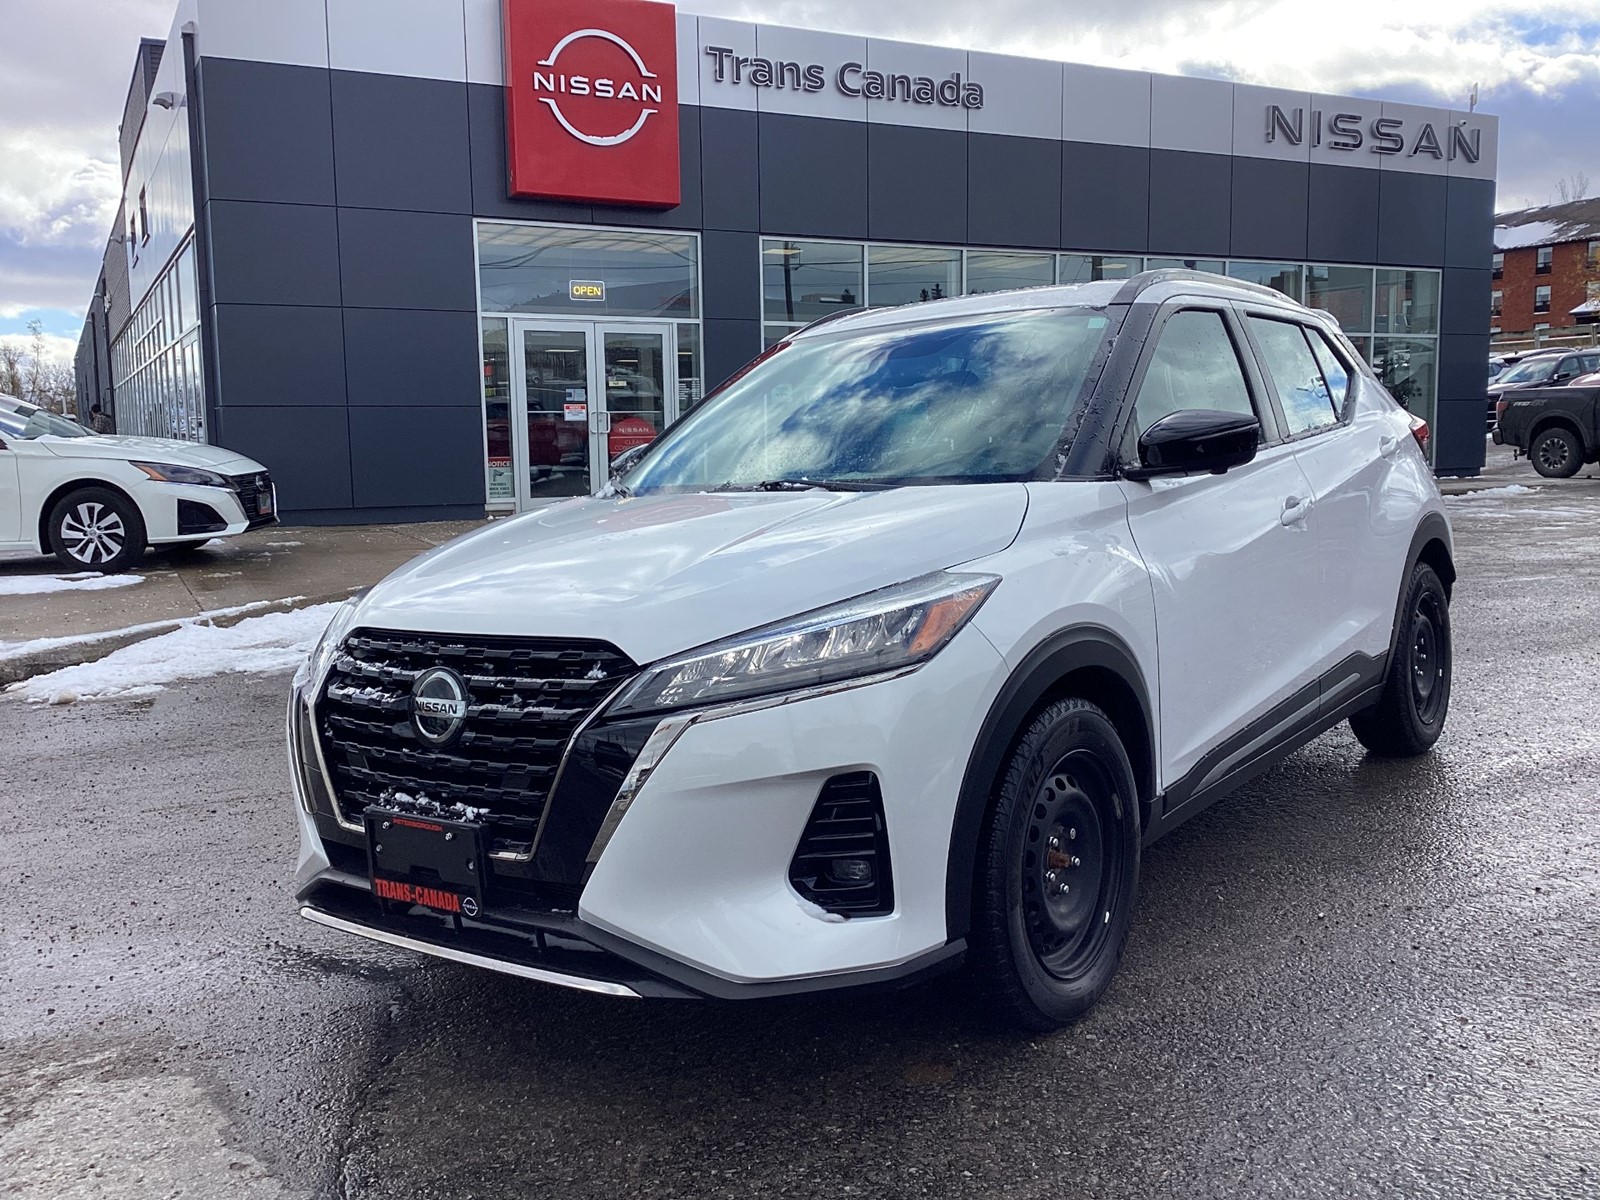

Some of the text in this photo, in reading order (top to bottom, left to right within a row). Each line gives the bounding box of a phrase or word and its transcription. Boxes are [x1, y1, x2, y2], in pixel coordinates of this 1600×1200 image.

[533, 71, 662, 103] NISSAN
[706, 45, 985, 108] Trans Canada
[1265, 104, 1482, 164] NISSAN
[573, 285, 601, 296] OPEN
[416, 700, 458, 715] NISSAN
[375, 879, 461, 913] TRANS-CANADA
